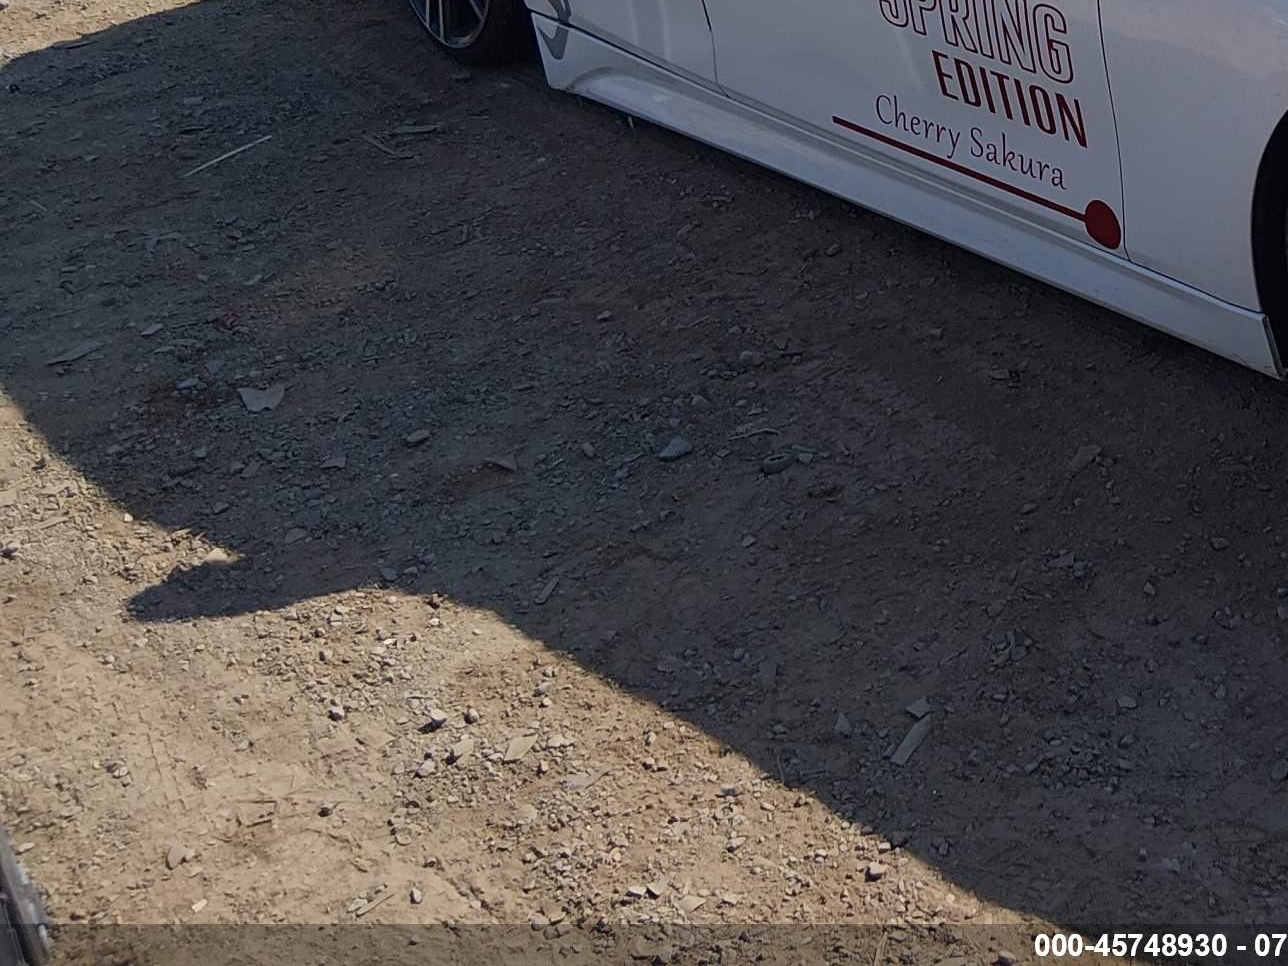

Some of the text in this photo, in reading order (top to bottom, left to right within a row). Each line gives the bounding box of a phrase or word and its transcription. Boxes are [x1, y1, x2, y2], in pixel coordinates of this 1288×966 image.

[875, 94, 1067, 190] Cherry Sakura
[931, 49, 1088, 149] EDITION
